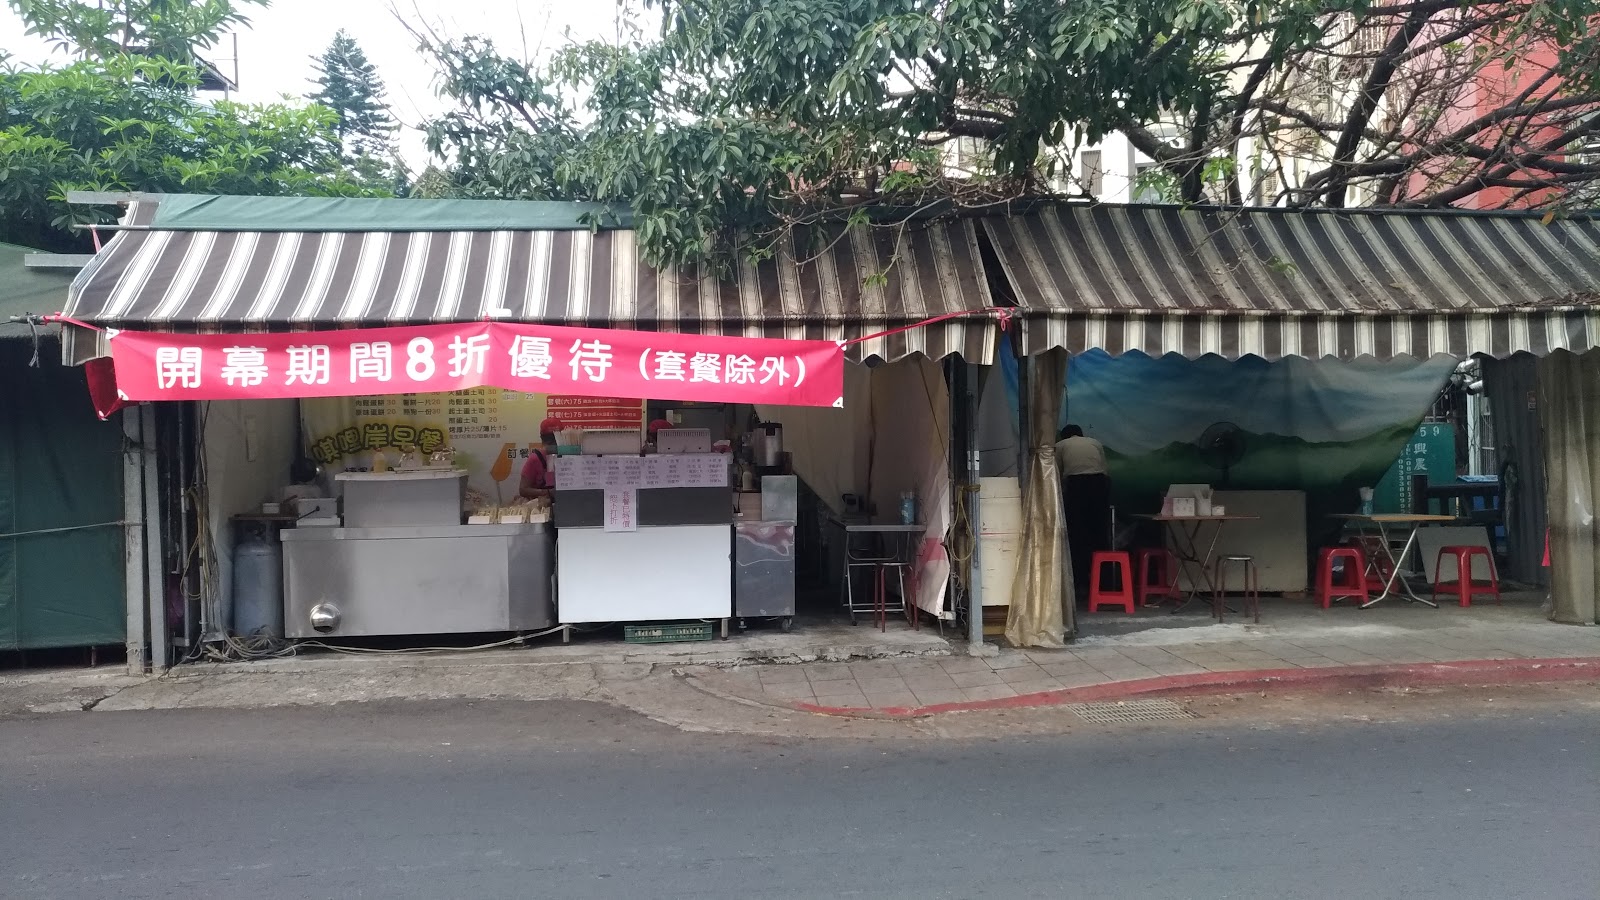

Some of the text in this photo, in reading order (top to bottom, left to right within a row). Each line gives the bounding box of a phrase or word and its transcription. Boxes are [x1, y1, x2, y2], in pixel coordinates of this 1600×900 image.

[155, 333, 807, 390] 開幕期間8折優待 (套餐除外)
